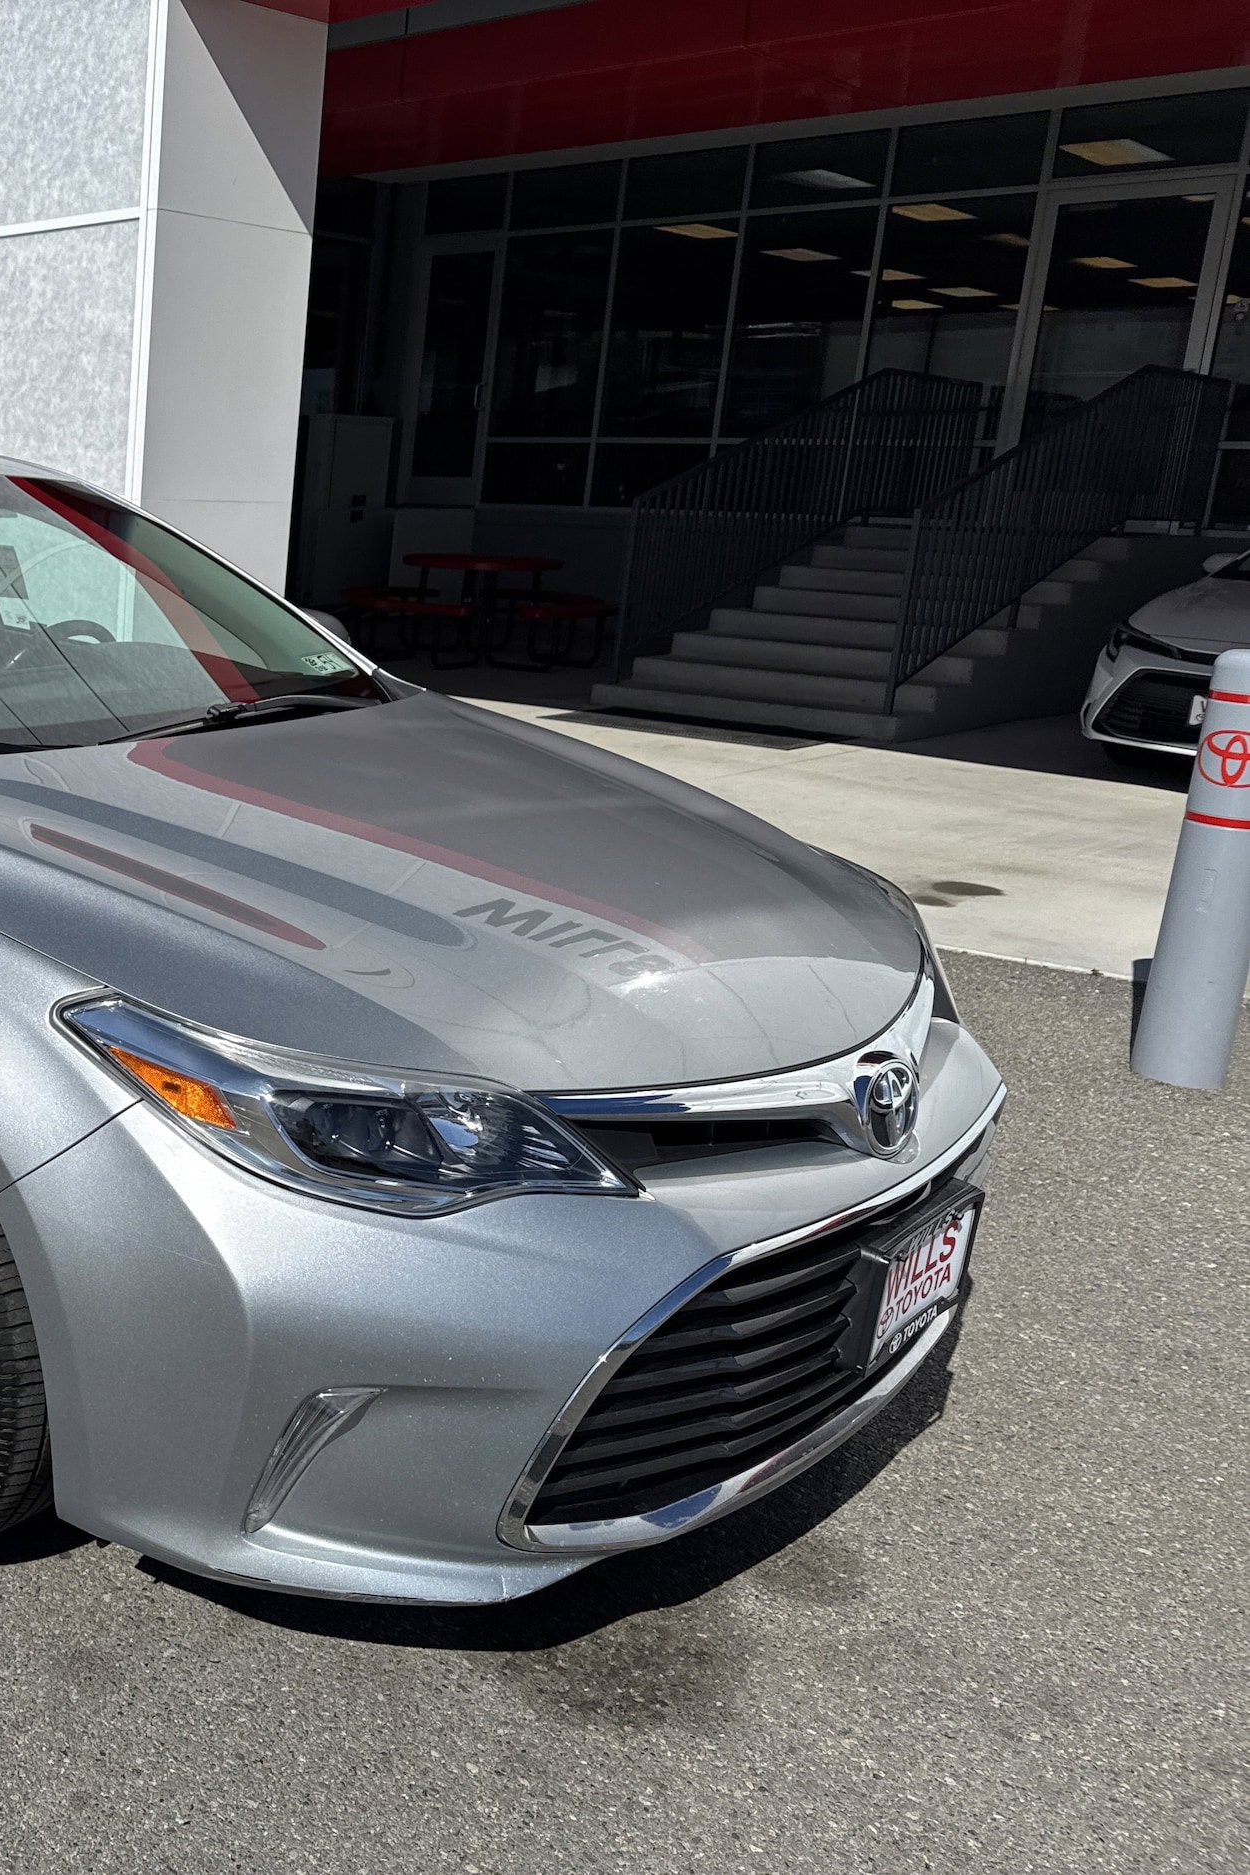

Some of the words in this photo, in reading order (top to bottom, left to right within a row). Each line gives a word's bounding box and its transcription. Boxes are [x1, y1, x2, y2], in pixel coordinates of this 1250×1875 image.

[886, 1219, 959, 1306] WILLS
[894, 1263, 951, 1321] TOYOTA
[902, 1304, 938, 1341] TOYOTA
